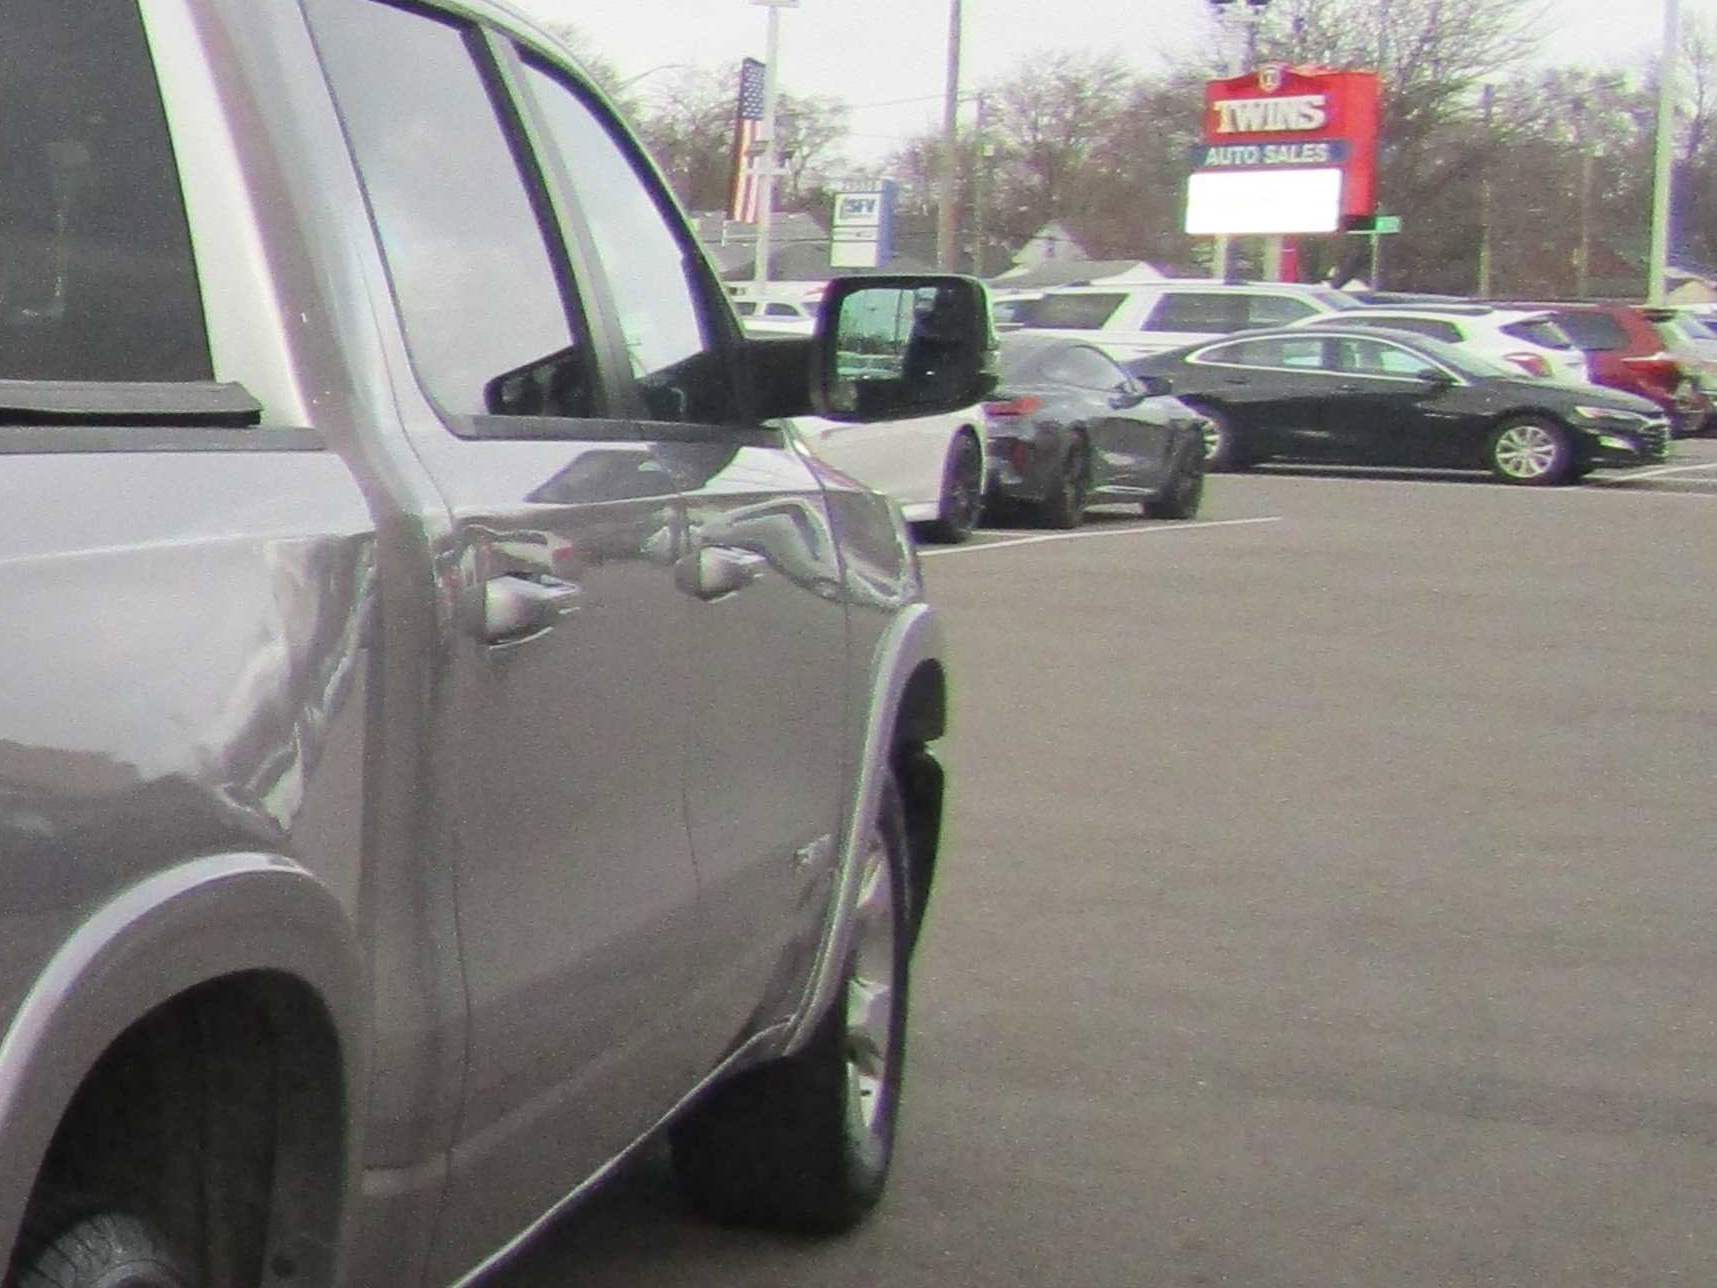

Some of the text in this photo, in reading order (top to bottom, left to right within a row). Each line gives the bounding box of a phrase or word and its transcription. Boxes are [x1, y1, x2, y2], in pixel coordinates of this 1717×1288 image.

[1213, 94, 1326, 134] TWINS
[1204, 142, 1329, 166] AUTO SALES
